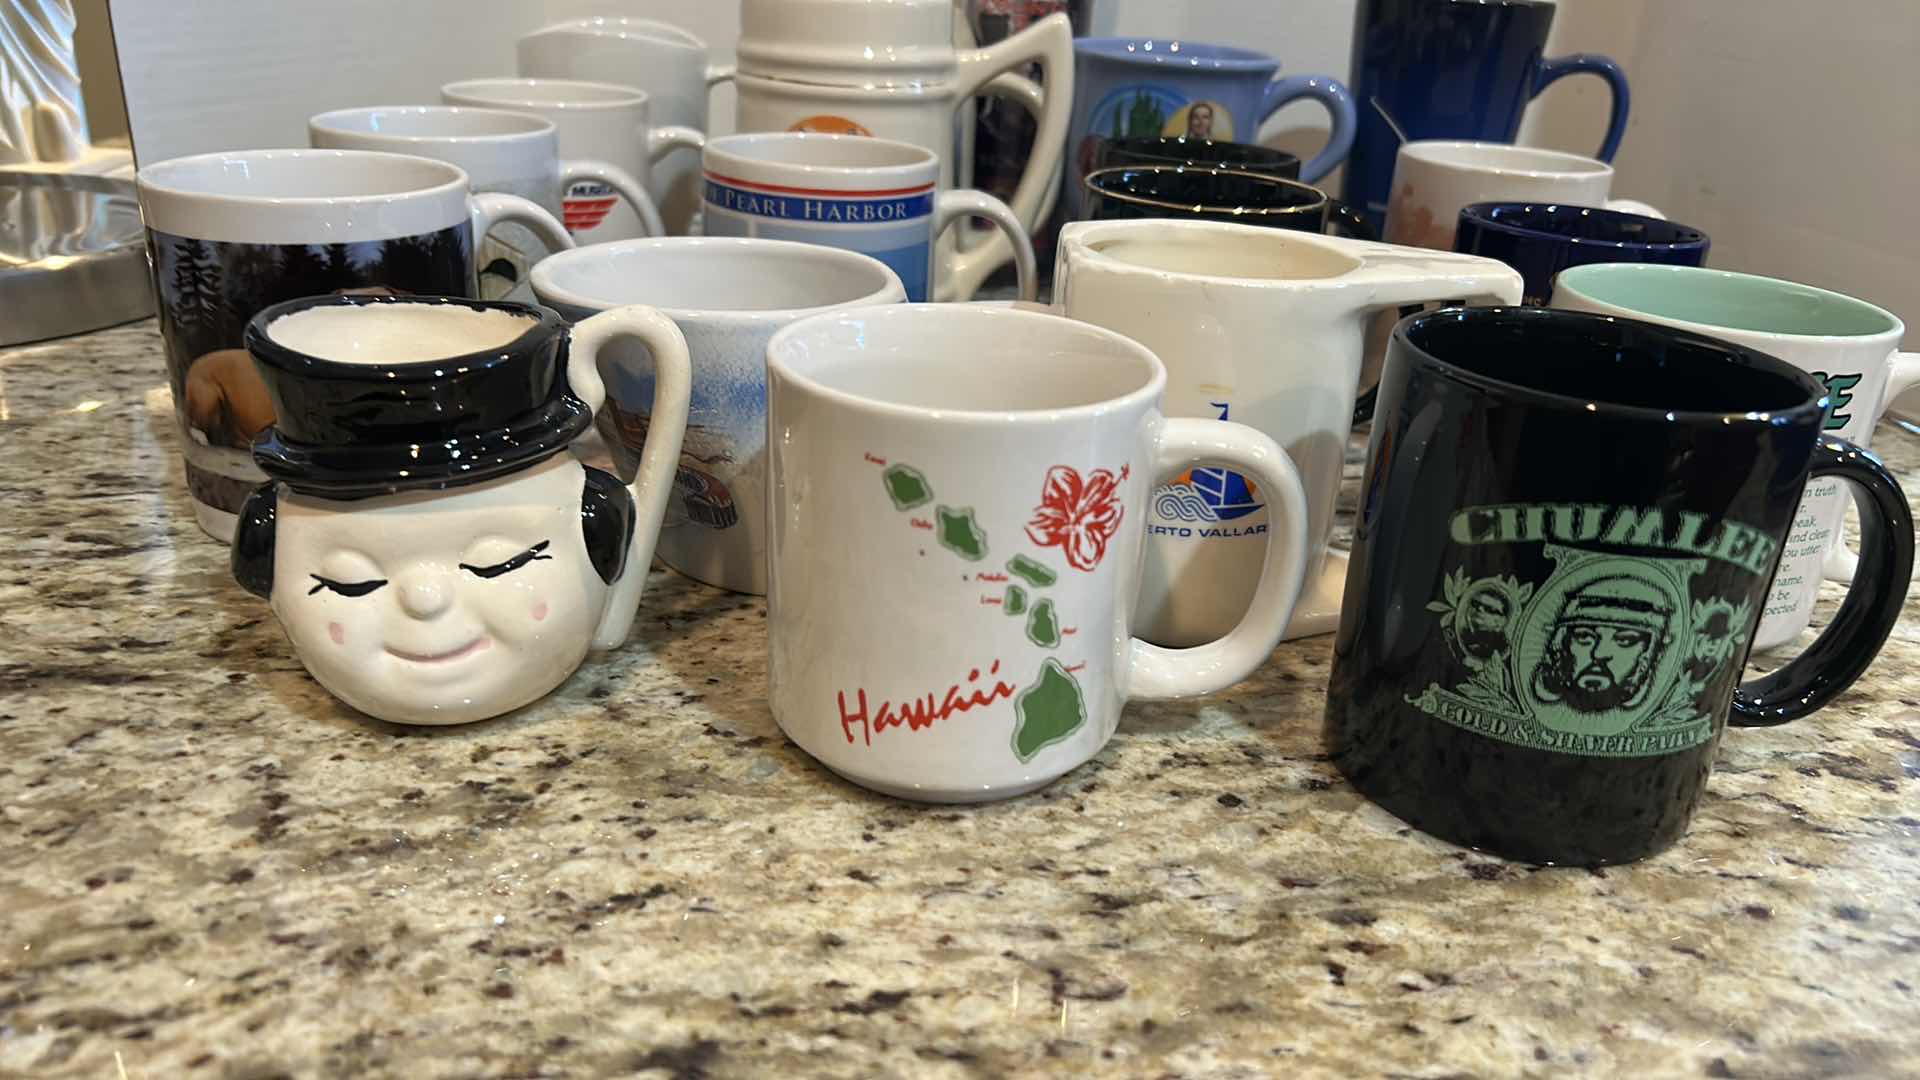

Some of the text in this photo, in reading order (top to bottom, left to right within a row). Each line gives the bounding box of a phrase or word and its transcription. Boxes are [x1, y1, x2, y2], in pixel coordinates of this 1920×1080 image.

[724, 189, 791, 217] PEARL
[803, 199, 909, 222] HARBOR
[1450, 504, 1776, 576] CHUMLEE
[838, 659, 1016, 746] Hawaii
